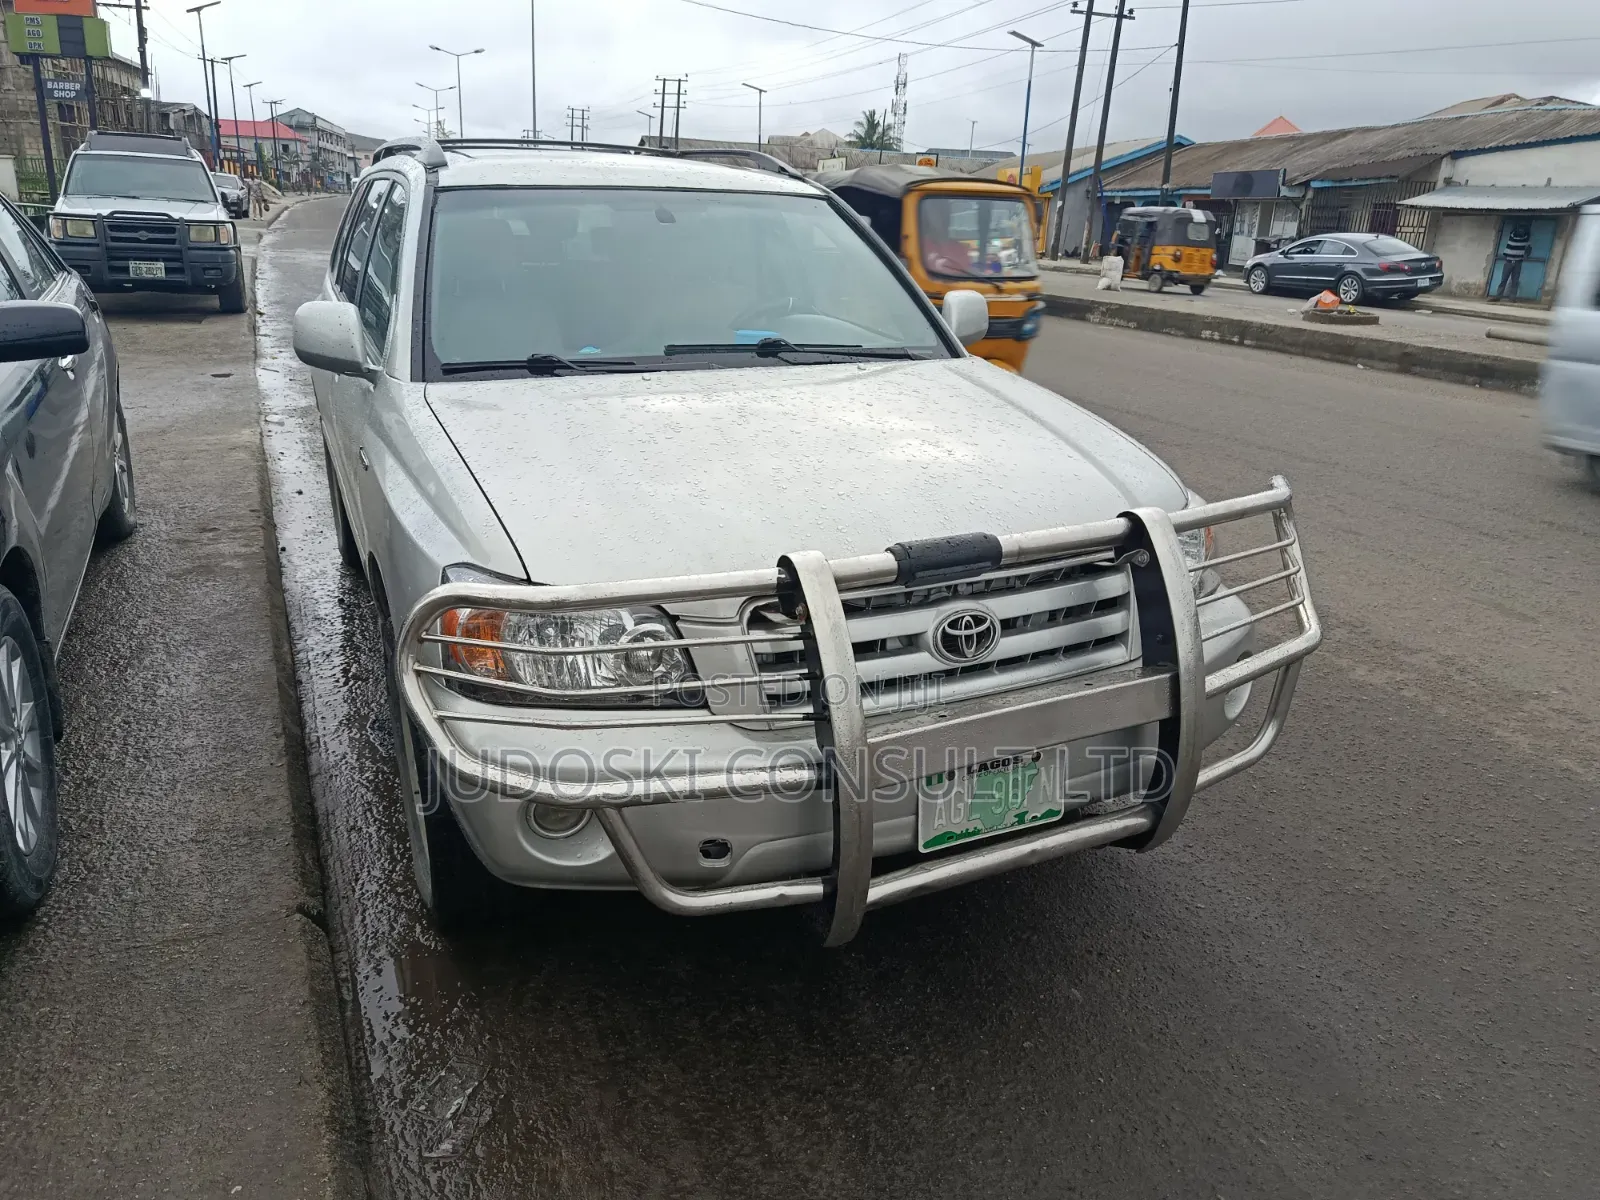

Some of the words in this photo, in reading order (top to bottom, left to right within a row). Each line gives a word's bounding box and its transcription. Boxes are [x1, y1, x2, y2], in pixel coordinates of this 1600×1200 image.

[25, 16, 41, 25] PMS
[27, 29, 42, 37] AGO
[28, 41, 43, 50] DPK
[47, 81, 81, 91] BARBER
[53, 90, 77, 98] SHOP
[967, 755, 1024, 775] LAGOS
